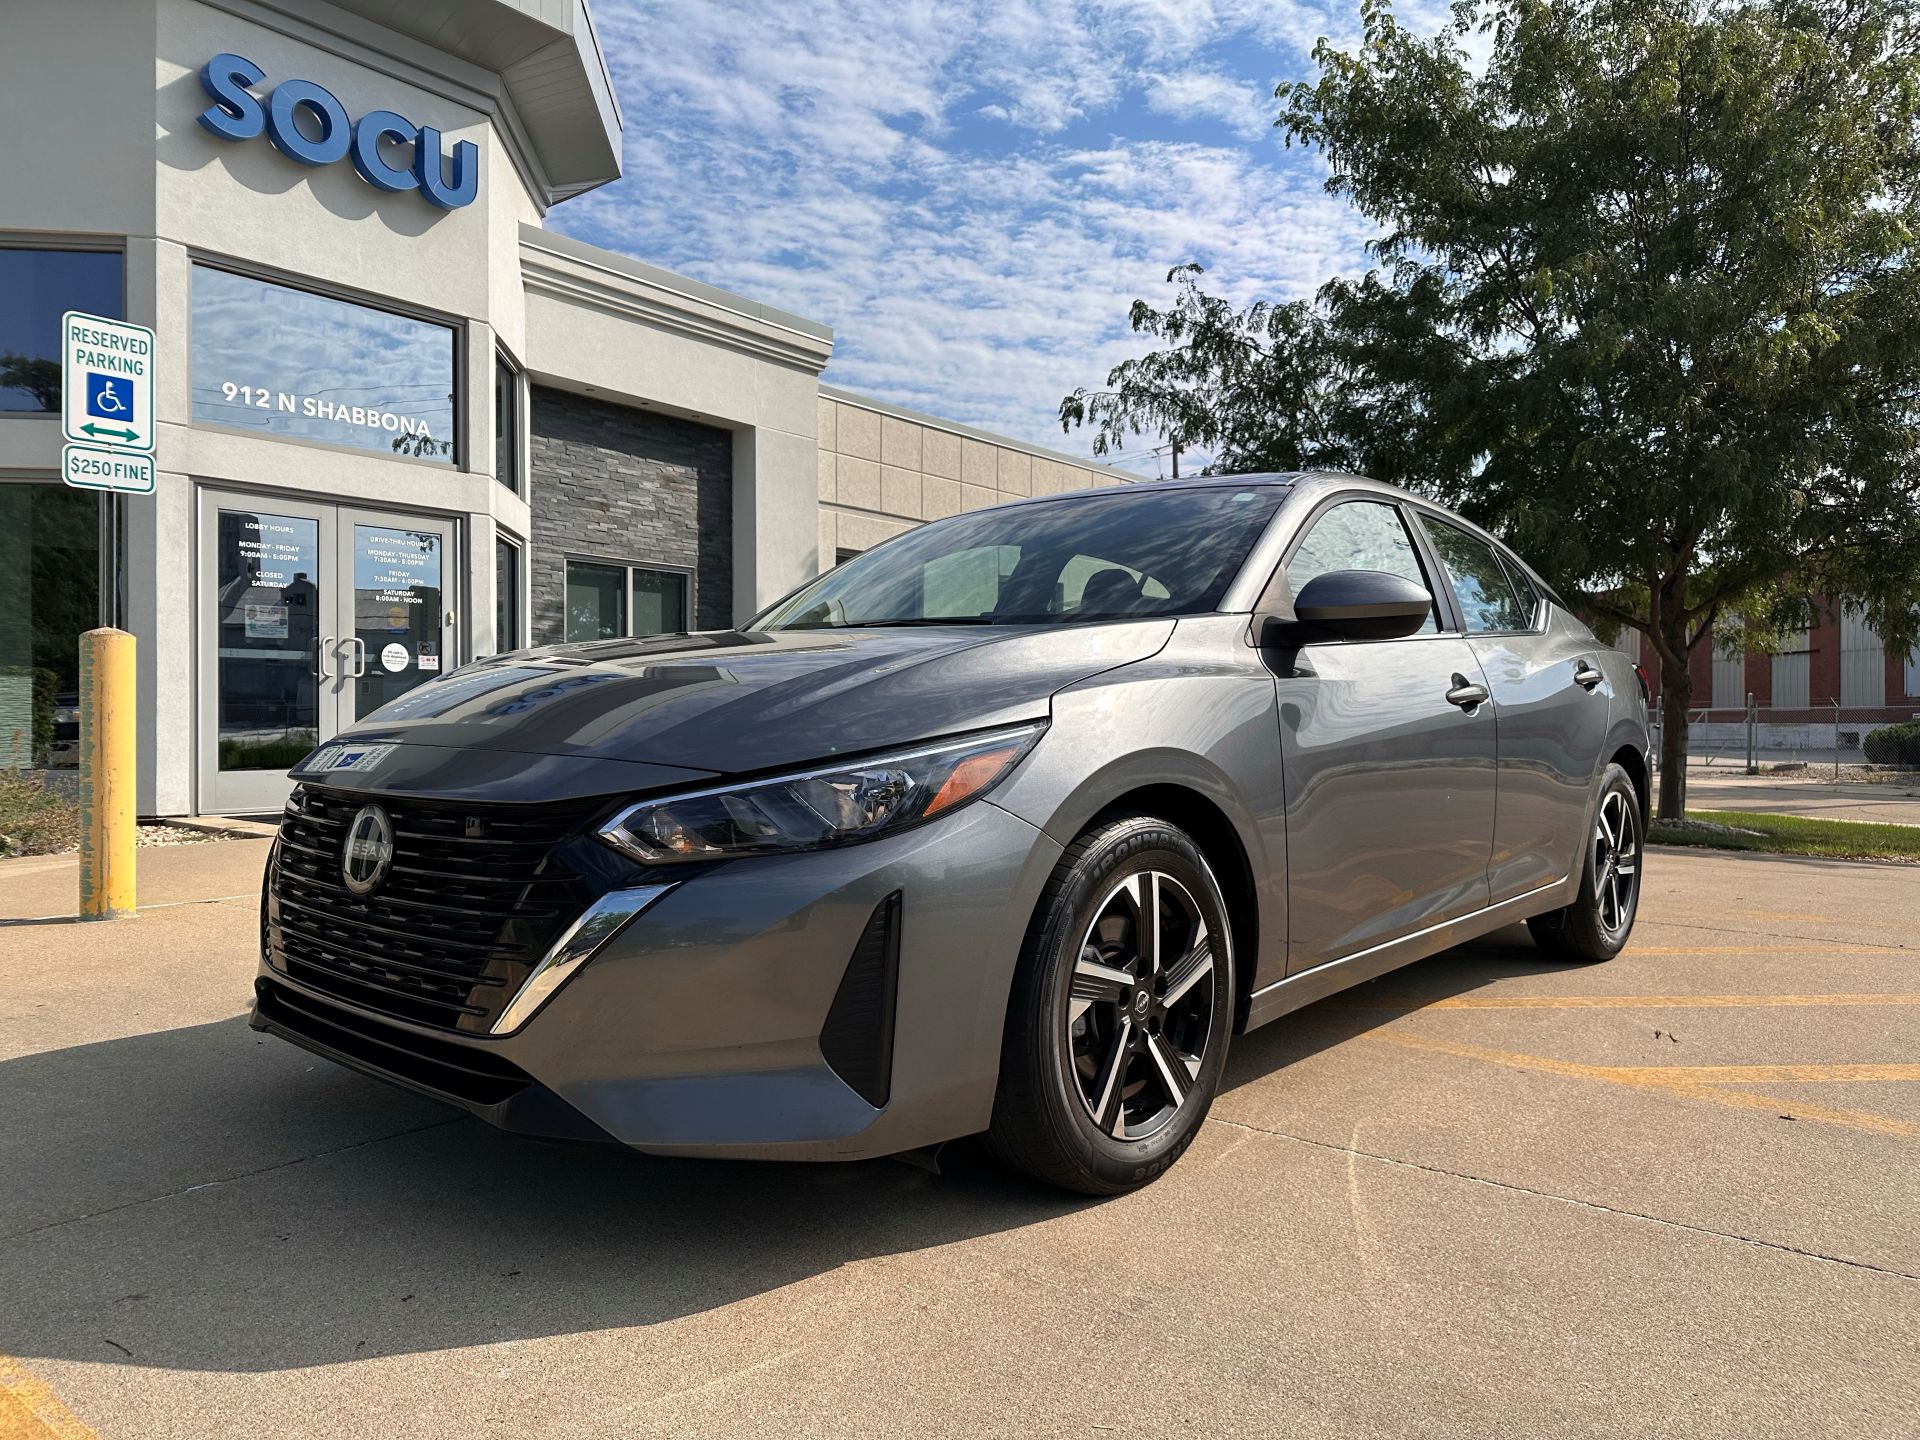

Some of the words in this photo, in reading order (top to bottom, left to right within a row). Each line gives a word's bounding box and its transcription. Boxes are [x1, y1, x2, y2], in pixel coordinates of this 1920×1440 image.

[195, 52, 479, 210] SOCU
[71, 325, 148, 355] RESERVED
[76, 348, 144, 376] PARKING
[221, 381, 270, 408] 912
[278, 391, 296, 413] N
[302, 397, 432, 438] SHABBONA
[70, 456, 112, 476] $250
[114, 463, 149, 481] FINE
[245, 522, 269, 531] LOBBY
[269, 525, 294, 533] HOURS
[238, 540, 271, 550] MONDAY
[275, 544, 300, 552] FRIDAY
[369, 536, 406, 546] DRIVE-THRU
[406, 540, 427, 548] HOURS
[240, 550, 268, 559] 9:00AM
[272, 553, 299, 562] 5:00PM
[367, 549, 396, 557] MONDAY
[398, 551, 430, 560] THURSDAY
[373, 556, 398, 564] 7:30AM
[255, 570, 284, 579] CLOSED
[373, 575, 398, 583] 7:30AM
[388, 570, 410, 578] FRIDAY
[251, 580, 288, 589] SATURDAY
[383, 589, 415, 597] SATURDAY
